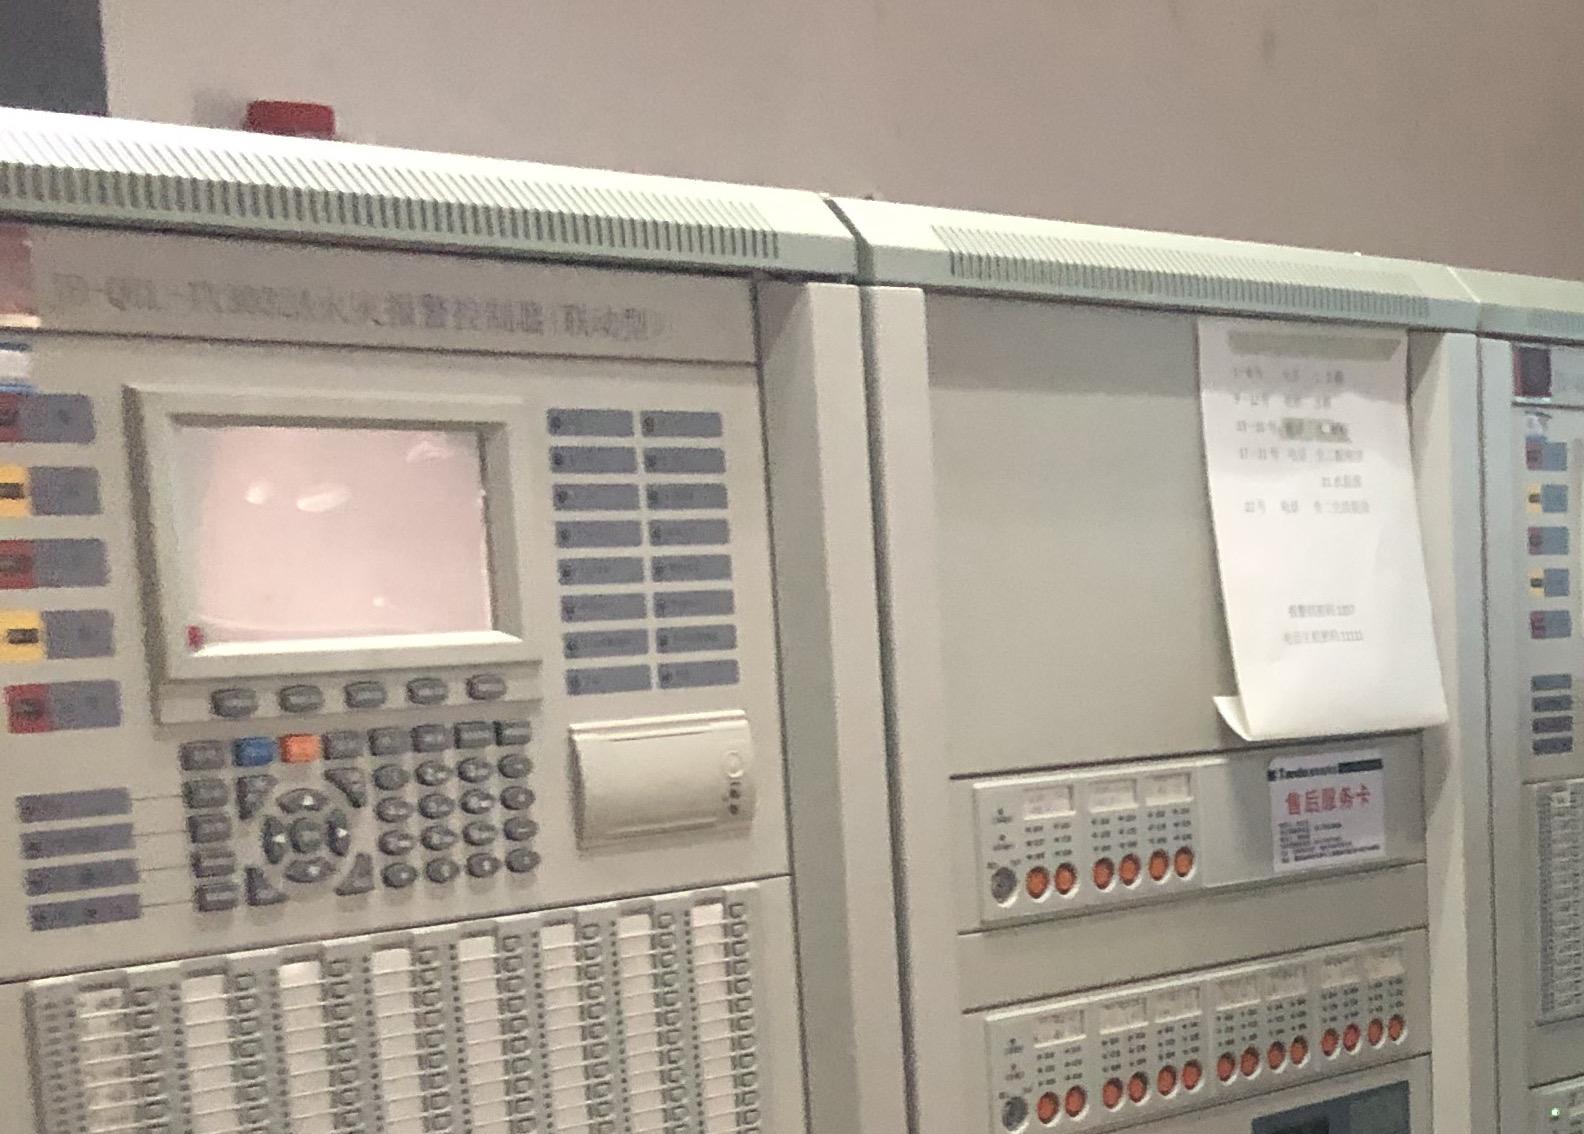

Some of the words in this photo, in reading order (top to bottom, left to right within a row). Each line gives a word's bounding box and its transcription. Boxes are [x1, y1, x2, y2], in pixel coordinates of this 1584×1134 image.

[1285, 782, 1371, 816] 售后服务卡
